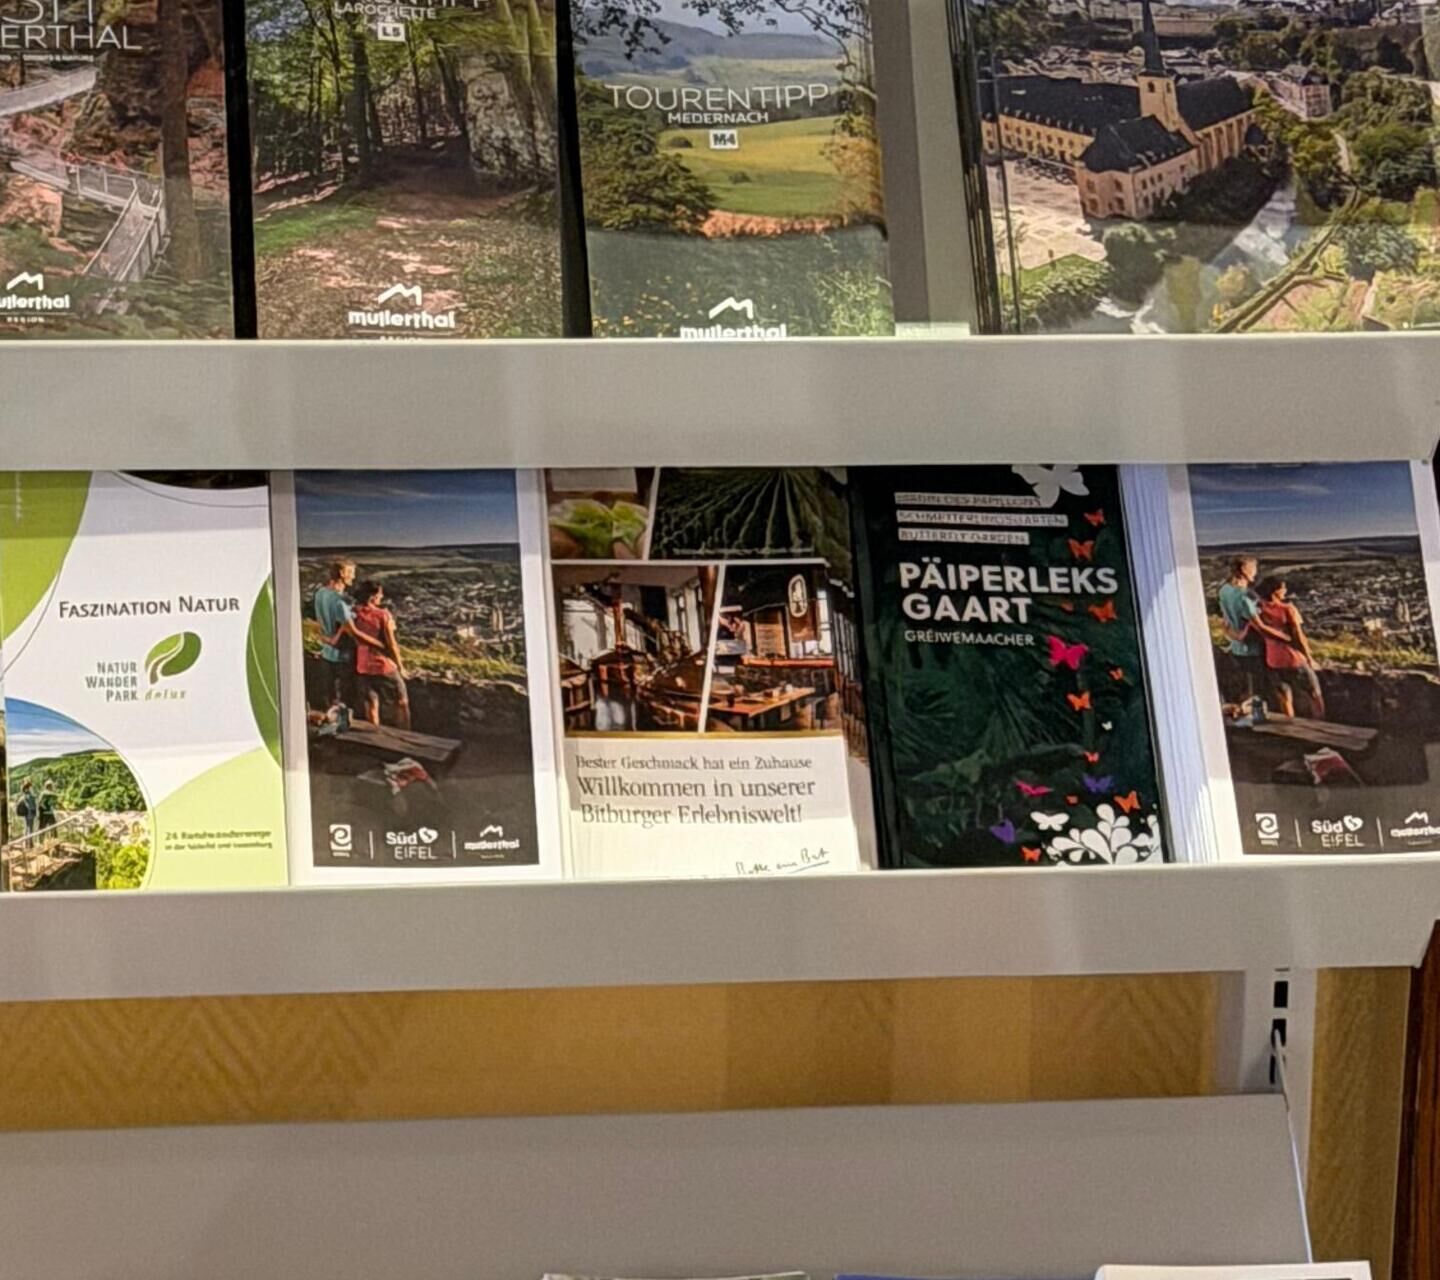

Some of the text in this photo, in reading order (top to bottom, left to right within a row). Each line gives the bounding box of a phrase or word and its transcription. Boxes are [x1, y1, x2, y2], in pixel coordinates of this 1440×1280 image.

[334, 1, 437, 20] LAROCHETTE
[605, 83, 829, 112] TOURENTIPP
[667, 110, 770, 125] MEDERNACH
[347, 310, 456, 329] mullerthal
[679, 322, 787, 338] mullerthal
[897, 556, 1119, 595] PÄIPERLEKS
[58, 594, 241, 619] FASZINATION NATUR
[901, 592, 1033, 625] GAART
[97, 661, 138, 674] NATUR
[85, 675, 138, 689] WANDER
[106, 689, 139, 703] PARK
[575, 754, 813, 770] Bester Geschmack hat ein Zuhause
[576, 775, 816, 798] Willkommen in unserer
[579, 804, 803, 829] Bitburger Erlebniswelt!
[1311, 819, 1344, 834] Süd
[385, 830, 418, 846] Süd
[1320, 833, 1365, 848] EIFEL
[393, 846, 439, 860] EIFEL
